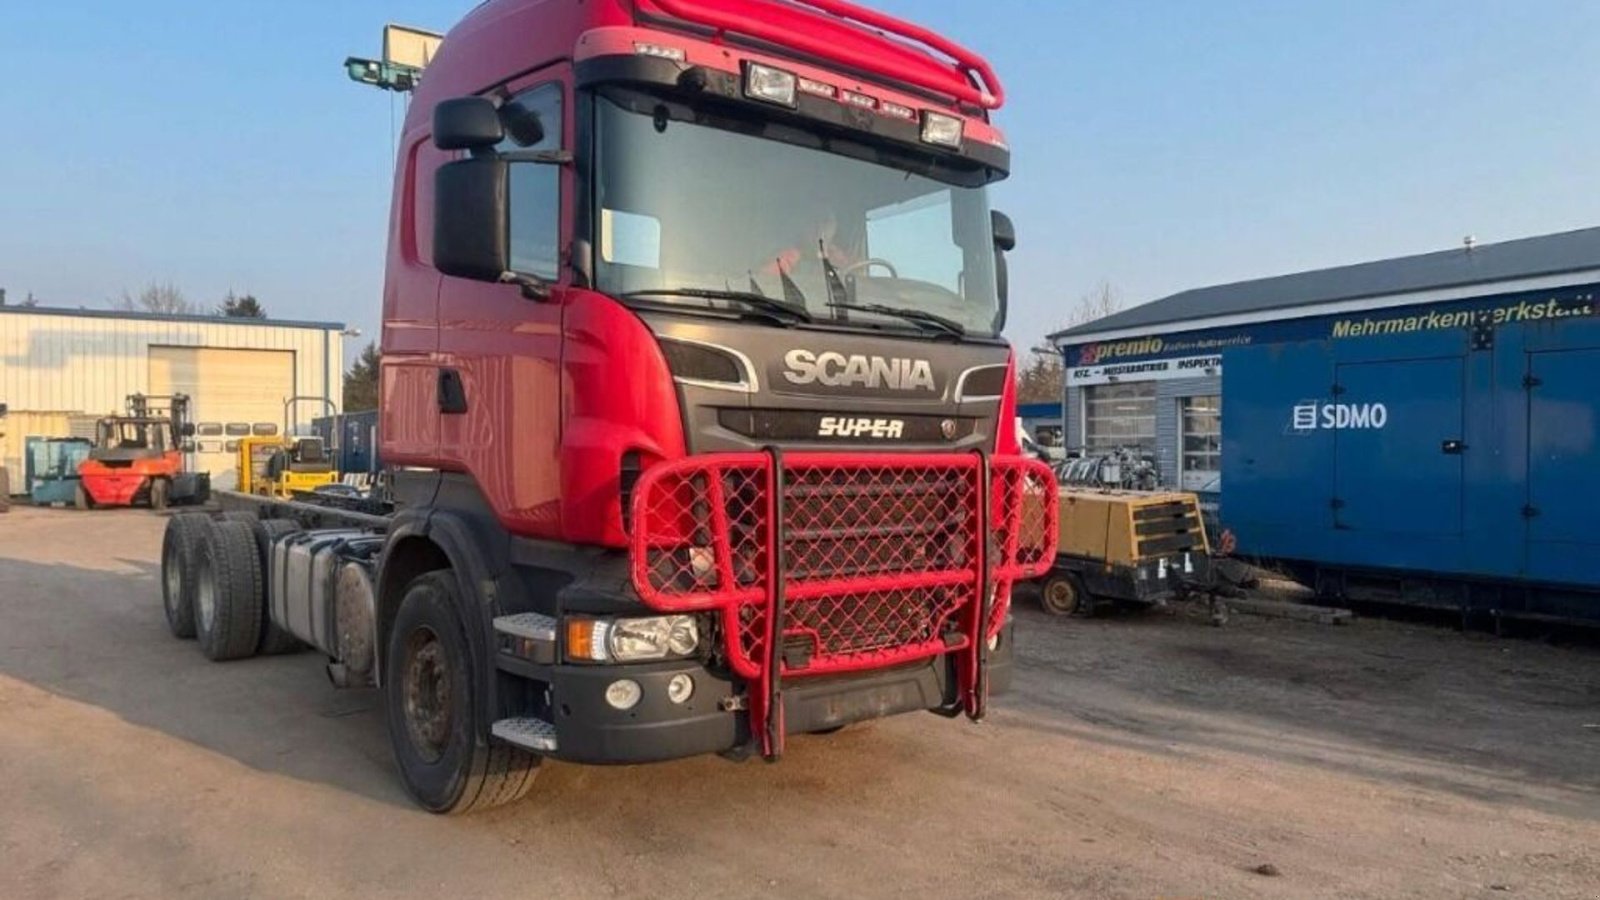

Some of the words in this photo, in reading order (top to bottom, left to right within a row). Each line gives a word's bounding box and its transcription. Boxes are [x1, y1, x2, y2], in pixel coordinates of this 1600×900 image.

[1094, 336, 1163, 362] premio
[783, 349, 936, 391] SCANIA
[818, 416, 904, 438] SUPER
[1321, 403, 1387, 429] SDMO
